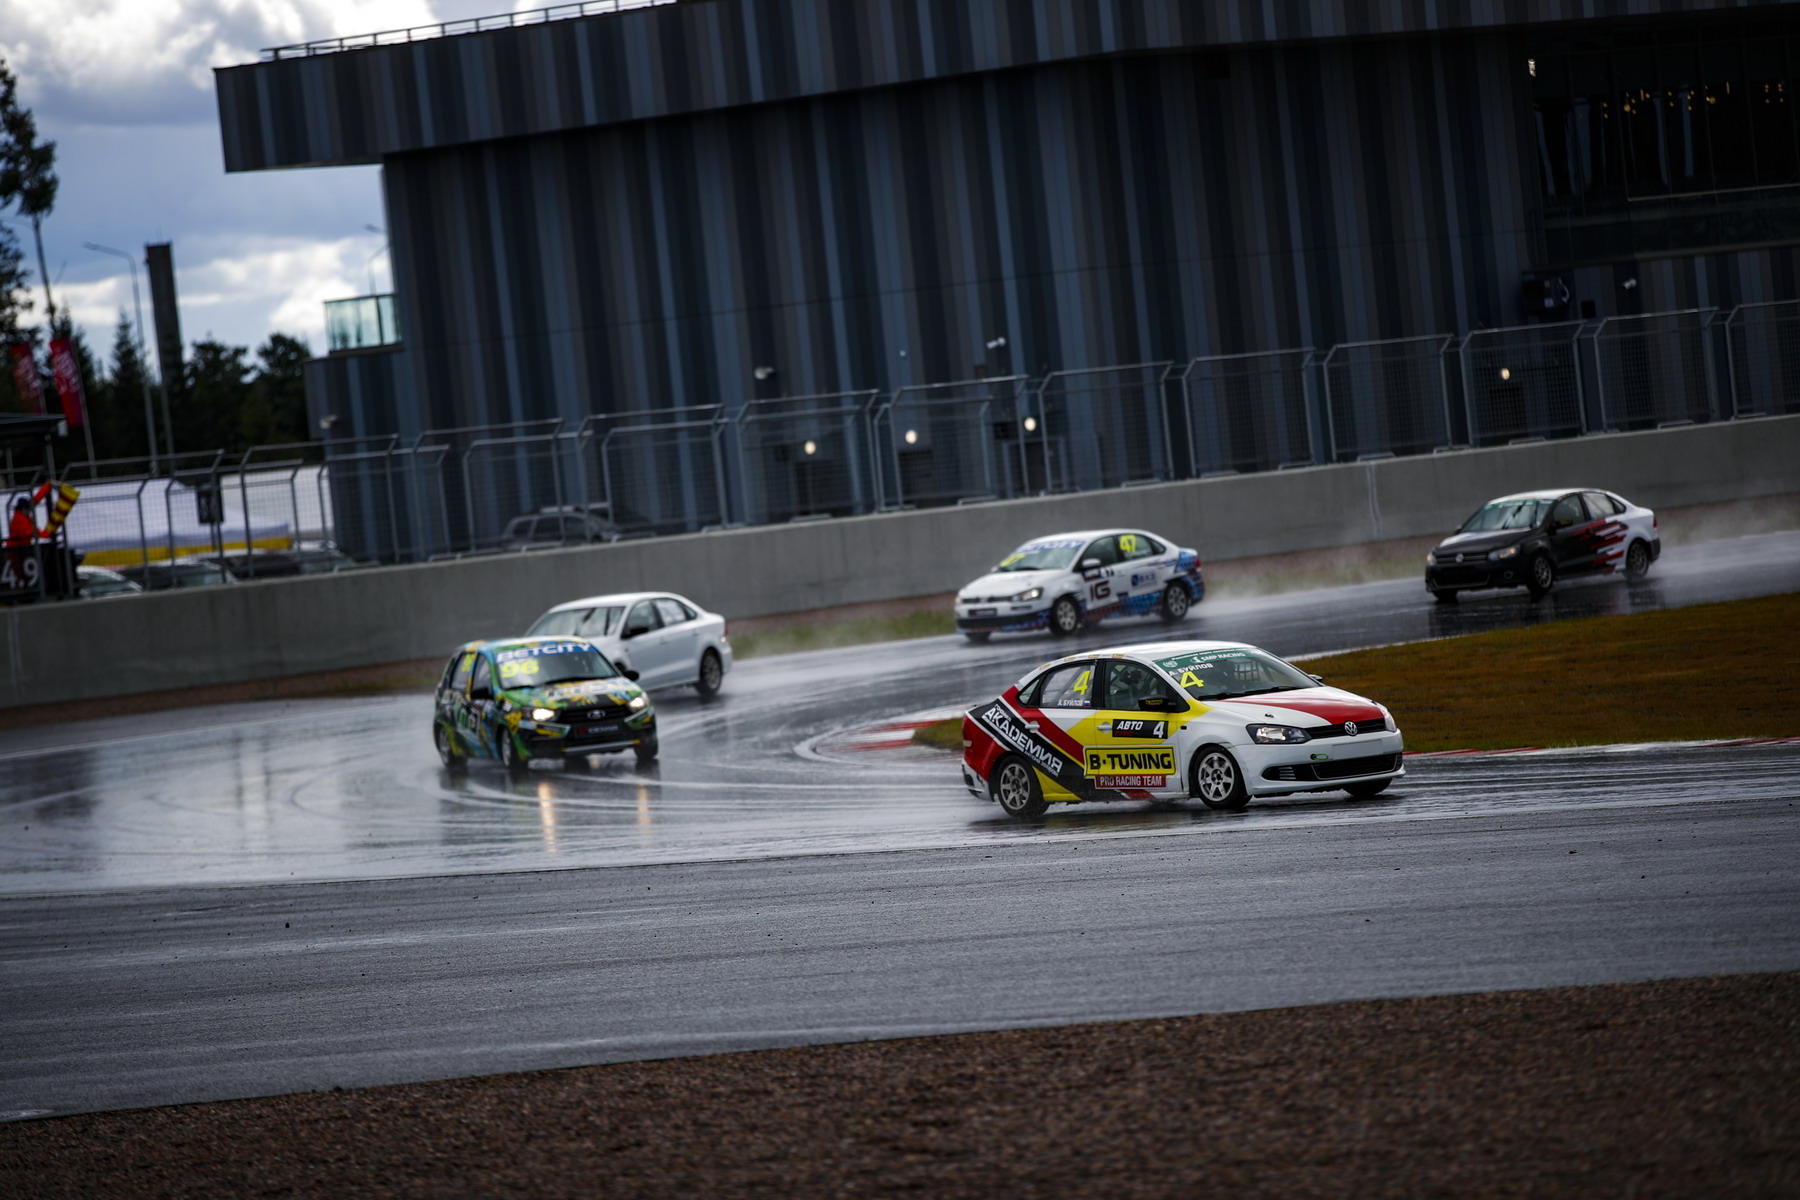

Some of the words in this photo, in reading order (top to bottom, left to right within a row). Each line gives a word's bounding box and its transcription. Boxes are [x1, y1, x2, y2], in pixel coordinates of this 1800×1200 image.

[1119, 534, 1136, 553] 47
[1090, 580, 1111, 601] IG
[497, 643, 591, 661] BETCITY
[1219, 652, 1246, 660] RACING
[502, 660, 539, 678] 96
[1179, 662, 1214, 674] БУЙЛОВ
[1073, 670, 1091, 695] 4
[1180, 671, 1204, 688] 4
[1117, 721, 1143, 731] АВТО
[1153, 721, 1165, 738] 4
[984, 707, 1063, 773] АКАДЕМИЯ
[1100, 776, 1115, 786] PRO
[1115, 776, 1142, 786] RACING
[1143, 776, 1162, 786] TEAM
